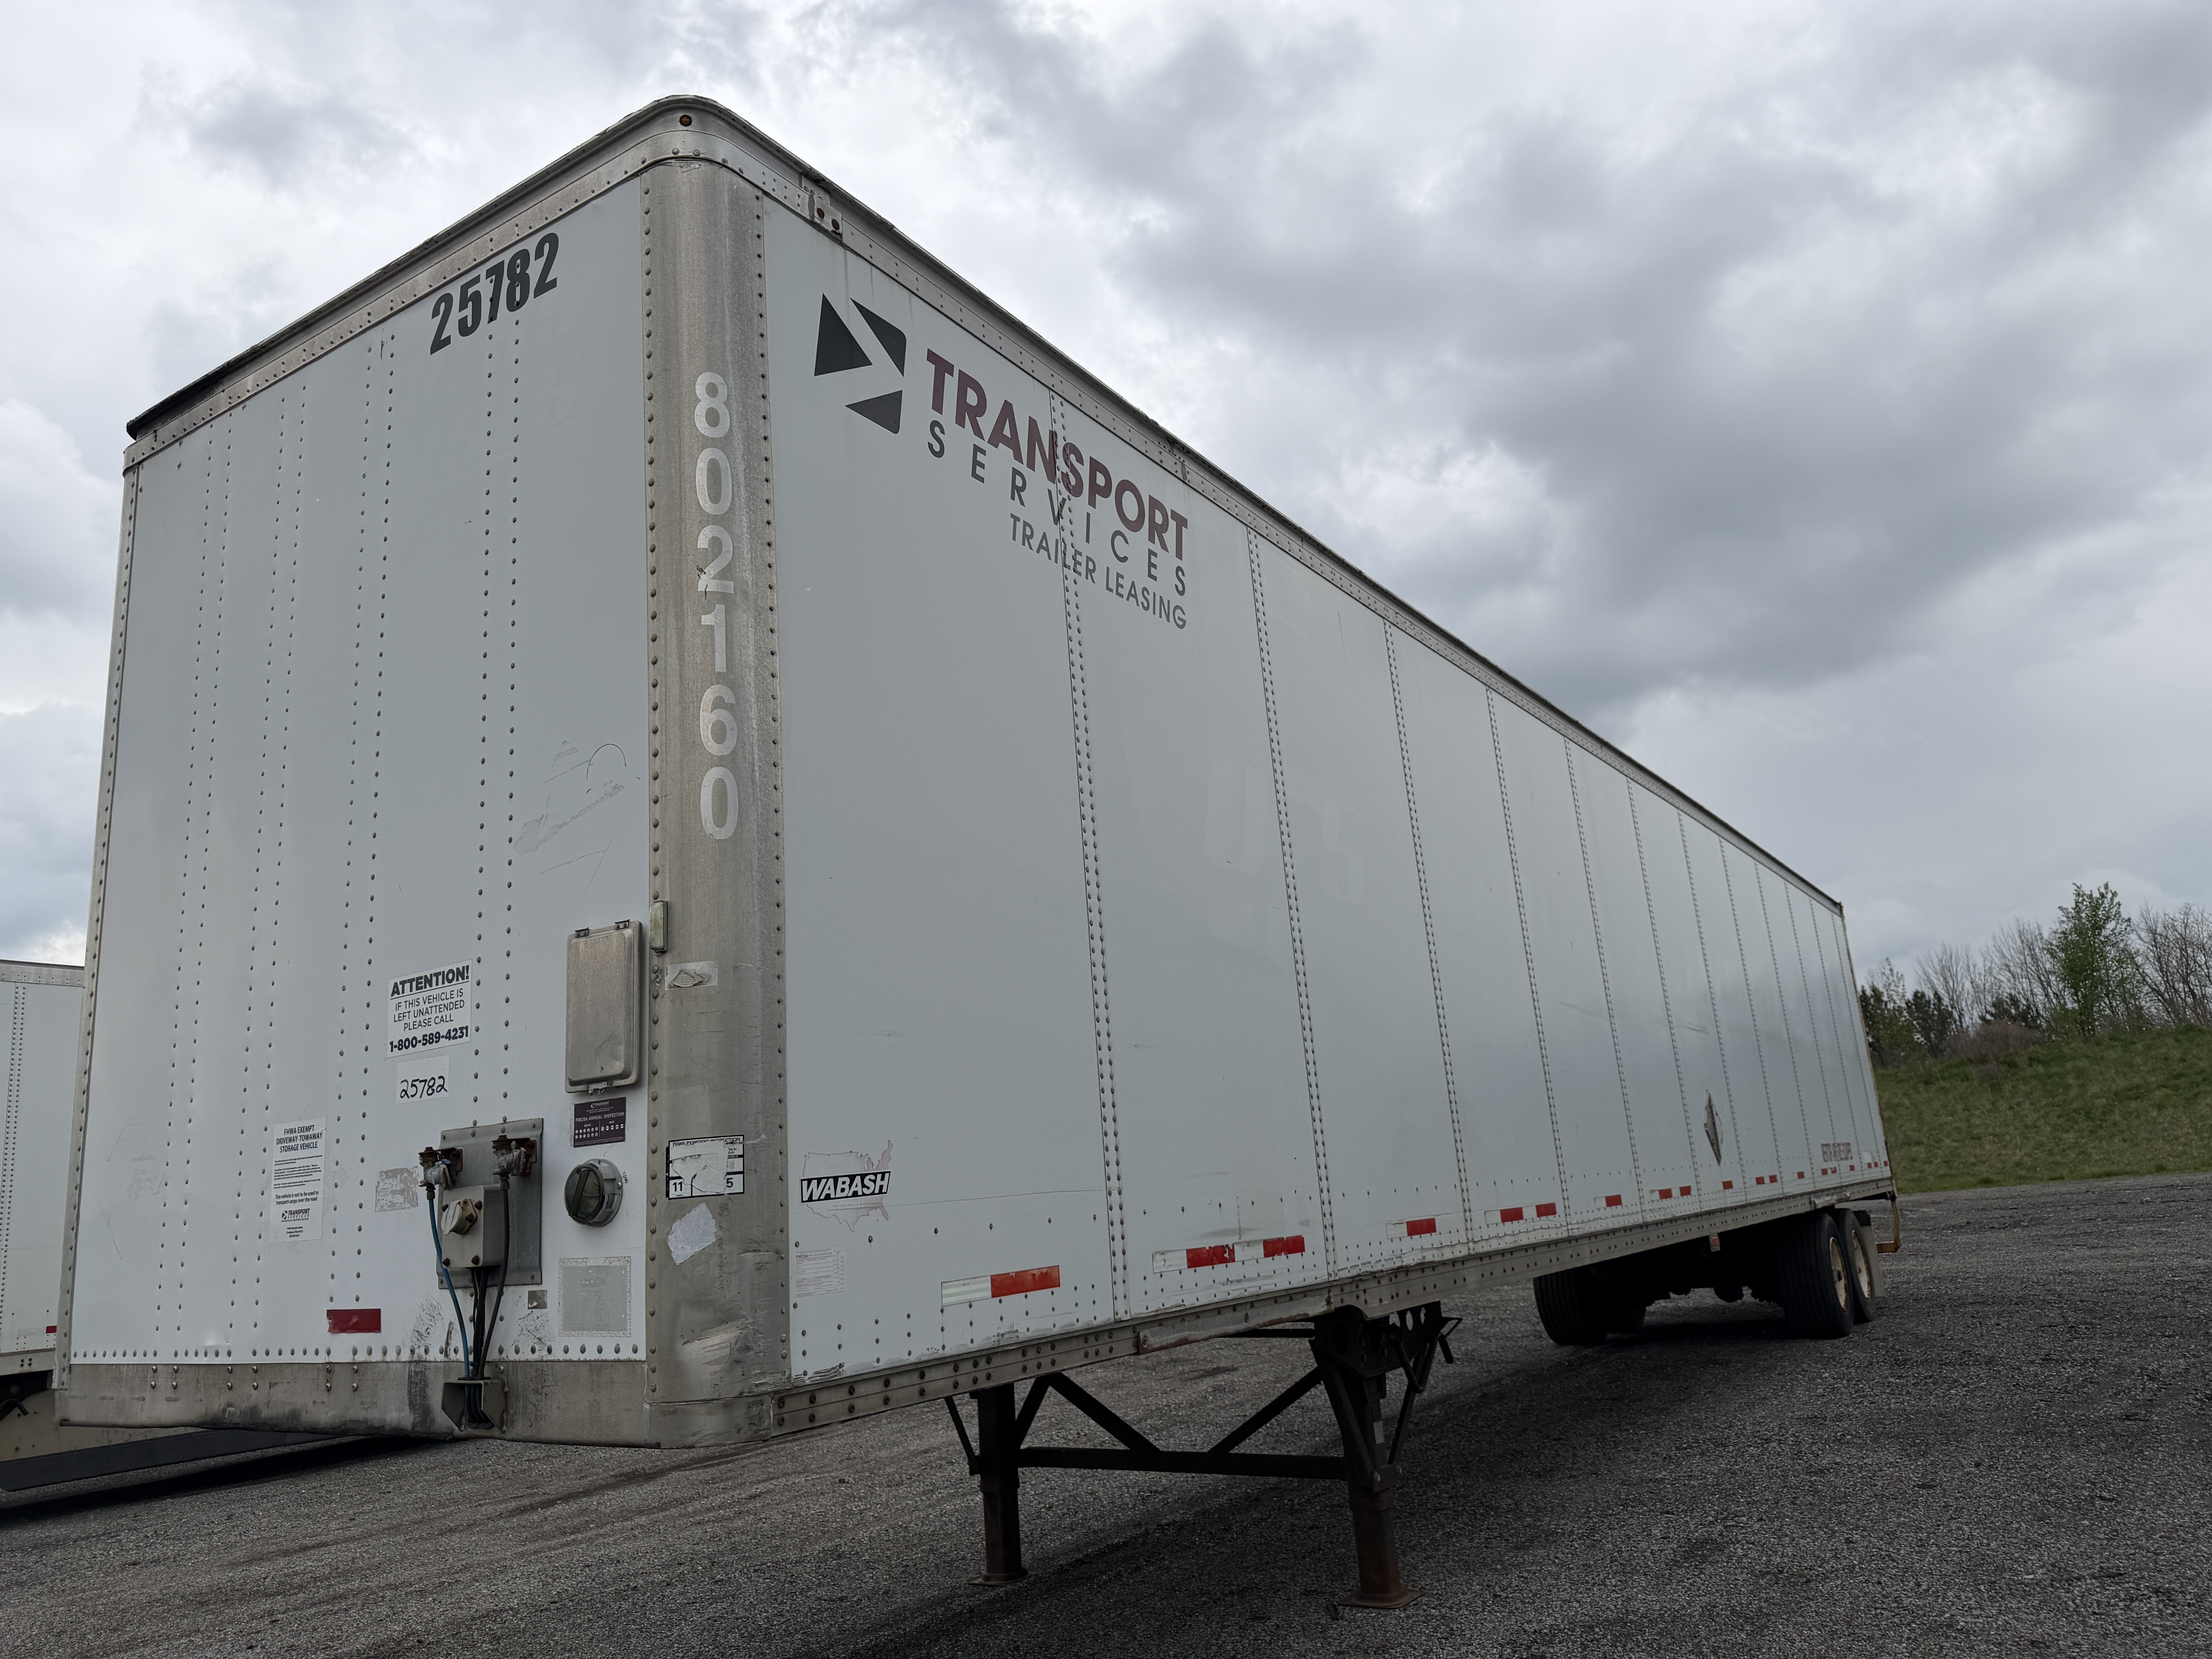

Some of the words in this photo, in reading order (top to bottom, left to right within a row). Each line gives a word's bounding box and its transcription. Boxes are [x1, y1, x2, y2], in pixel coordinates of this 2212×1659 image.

[430, 232, 559, 355] 25782
[927, 348, 1188, 561] TRANSPORT
[927, 420, 1186, 596] SERVICES
[1010, 513, 1096, 584] TRAILER
[1106, 566, 1187, 629] LEASING
[694, 371, 739, 840] 802160
[390, 965, 469, 997] ATTENTION!
[393, 1011, 411, 1022] LEFT
[414, 1000, 465, 1018] UNATTENDED
[395, 1002, 402, 1011] IF
[404, 998, 420, 1009] THIS
[422, 990, 454, 1005] VEHICLE
[457, 988, 464, 998] IS
[404, 1018, 431, 1031] PLEASE
[434, 1013, 453, 1024] CALL
[390, 1025, 469, 1053] 1-800-589-4231
[400, 1075, 448, 1099] 25782
[276, 1132, 323, 1145] DRIVEWAY-TOWAWAY
[284, 1127, 296, 1135] FHWA
[297, 1125, 315, 1133] EXEMPT
[280, 1144, 299, 1153] STORAGE
[300, 1141, 318, 1150] VEHICLE
[673, 1182, 683, 1192] 11
[802, 1173, 890, 1201] WABASH
